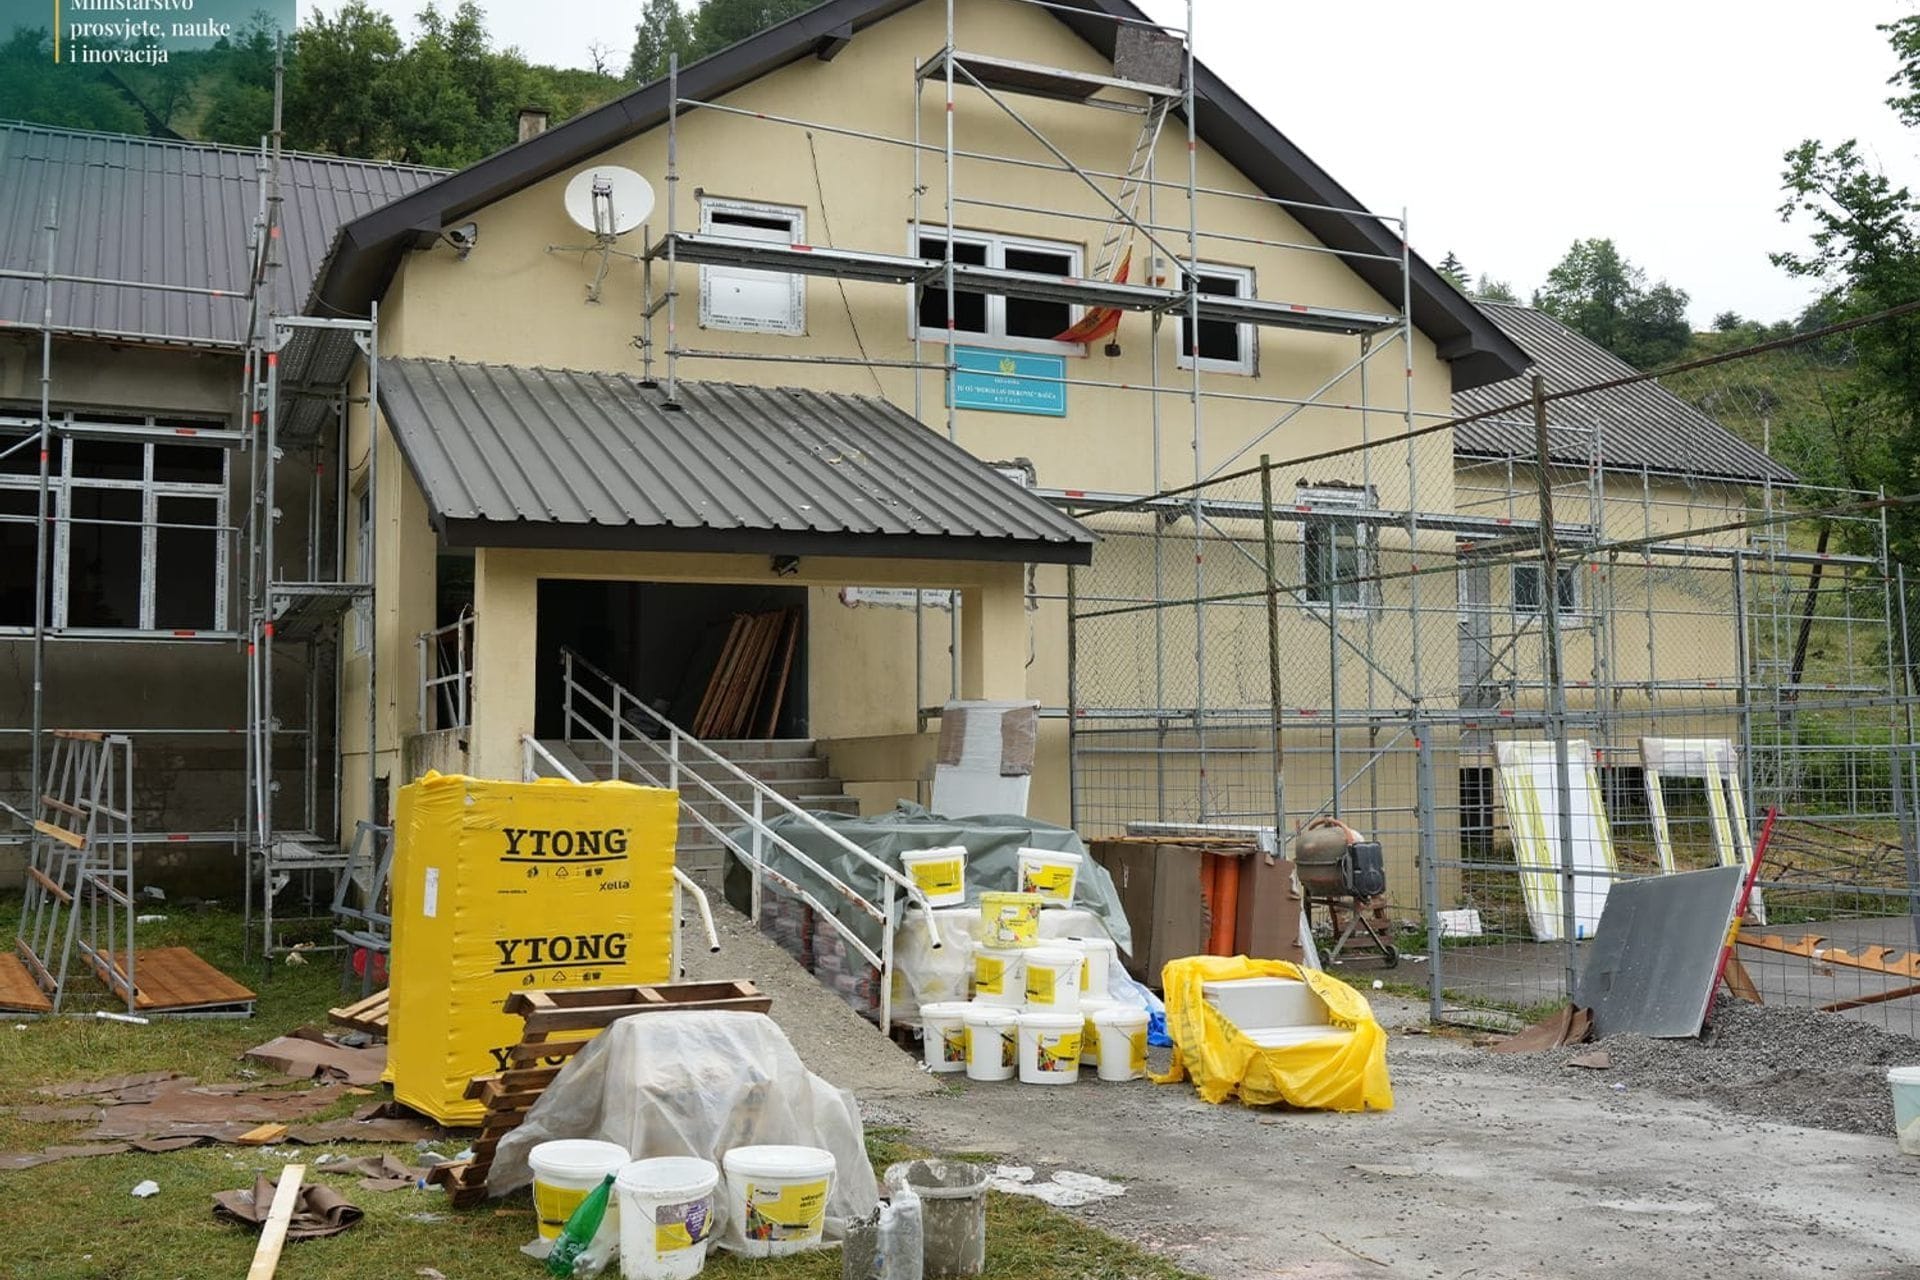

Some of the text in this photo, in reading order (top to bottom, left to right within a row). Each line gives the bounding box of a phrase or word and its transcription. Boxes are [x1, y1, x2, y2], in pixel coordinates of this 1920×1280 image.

[503, 828, 627, 856] YTONG
[599, 880, 630, 892] xella
[496, 933, 626, 965] YTONG
